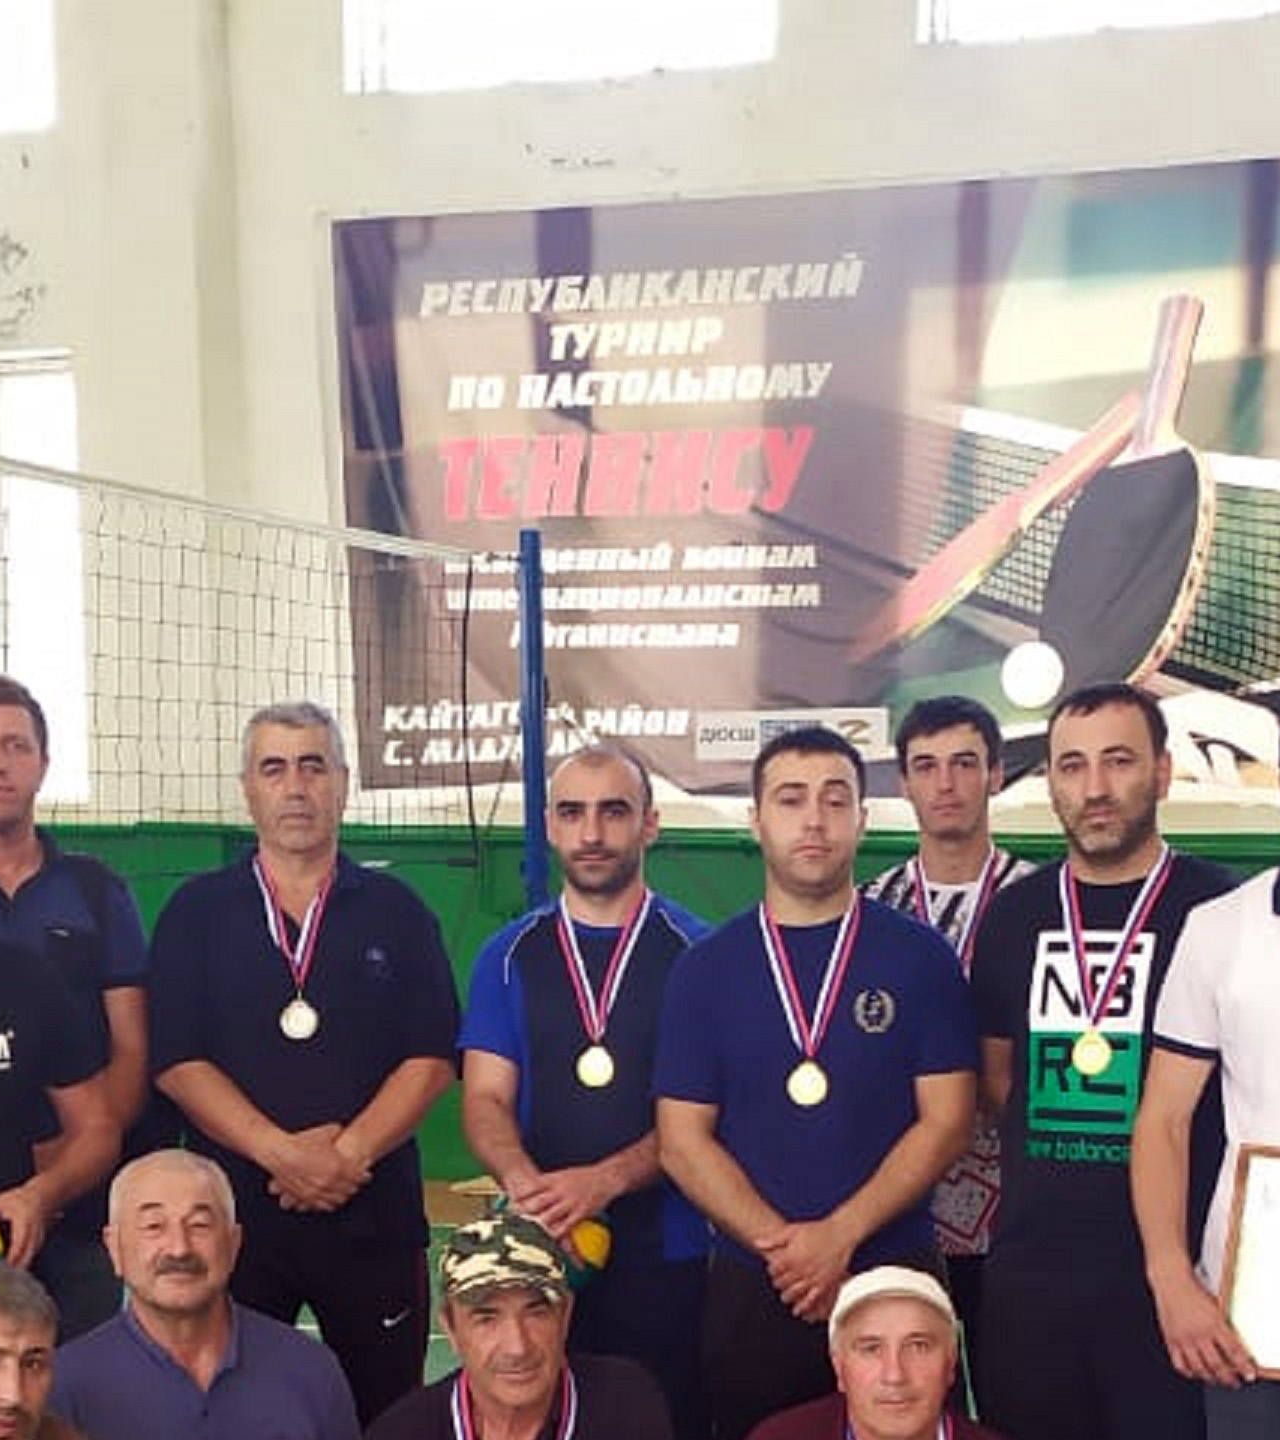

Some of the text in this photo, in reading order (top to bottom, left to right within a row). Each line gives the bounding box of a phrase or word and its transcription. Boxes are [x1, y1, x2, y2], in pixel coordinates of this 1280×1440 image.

[419, 251, 865, 317] РЕСПУБЛИКАНСКИЙ
[549, 316, 724, 361] ТУРНИР
[447, 361, 832, 410] ПО НАСТОЛЬНОМУ
[439, 424, 814, 523] ТЕННИСУ
[447, 583, 821, 611] интенационалистам
[584, 703, 690, 736] РАЙОН
